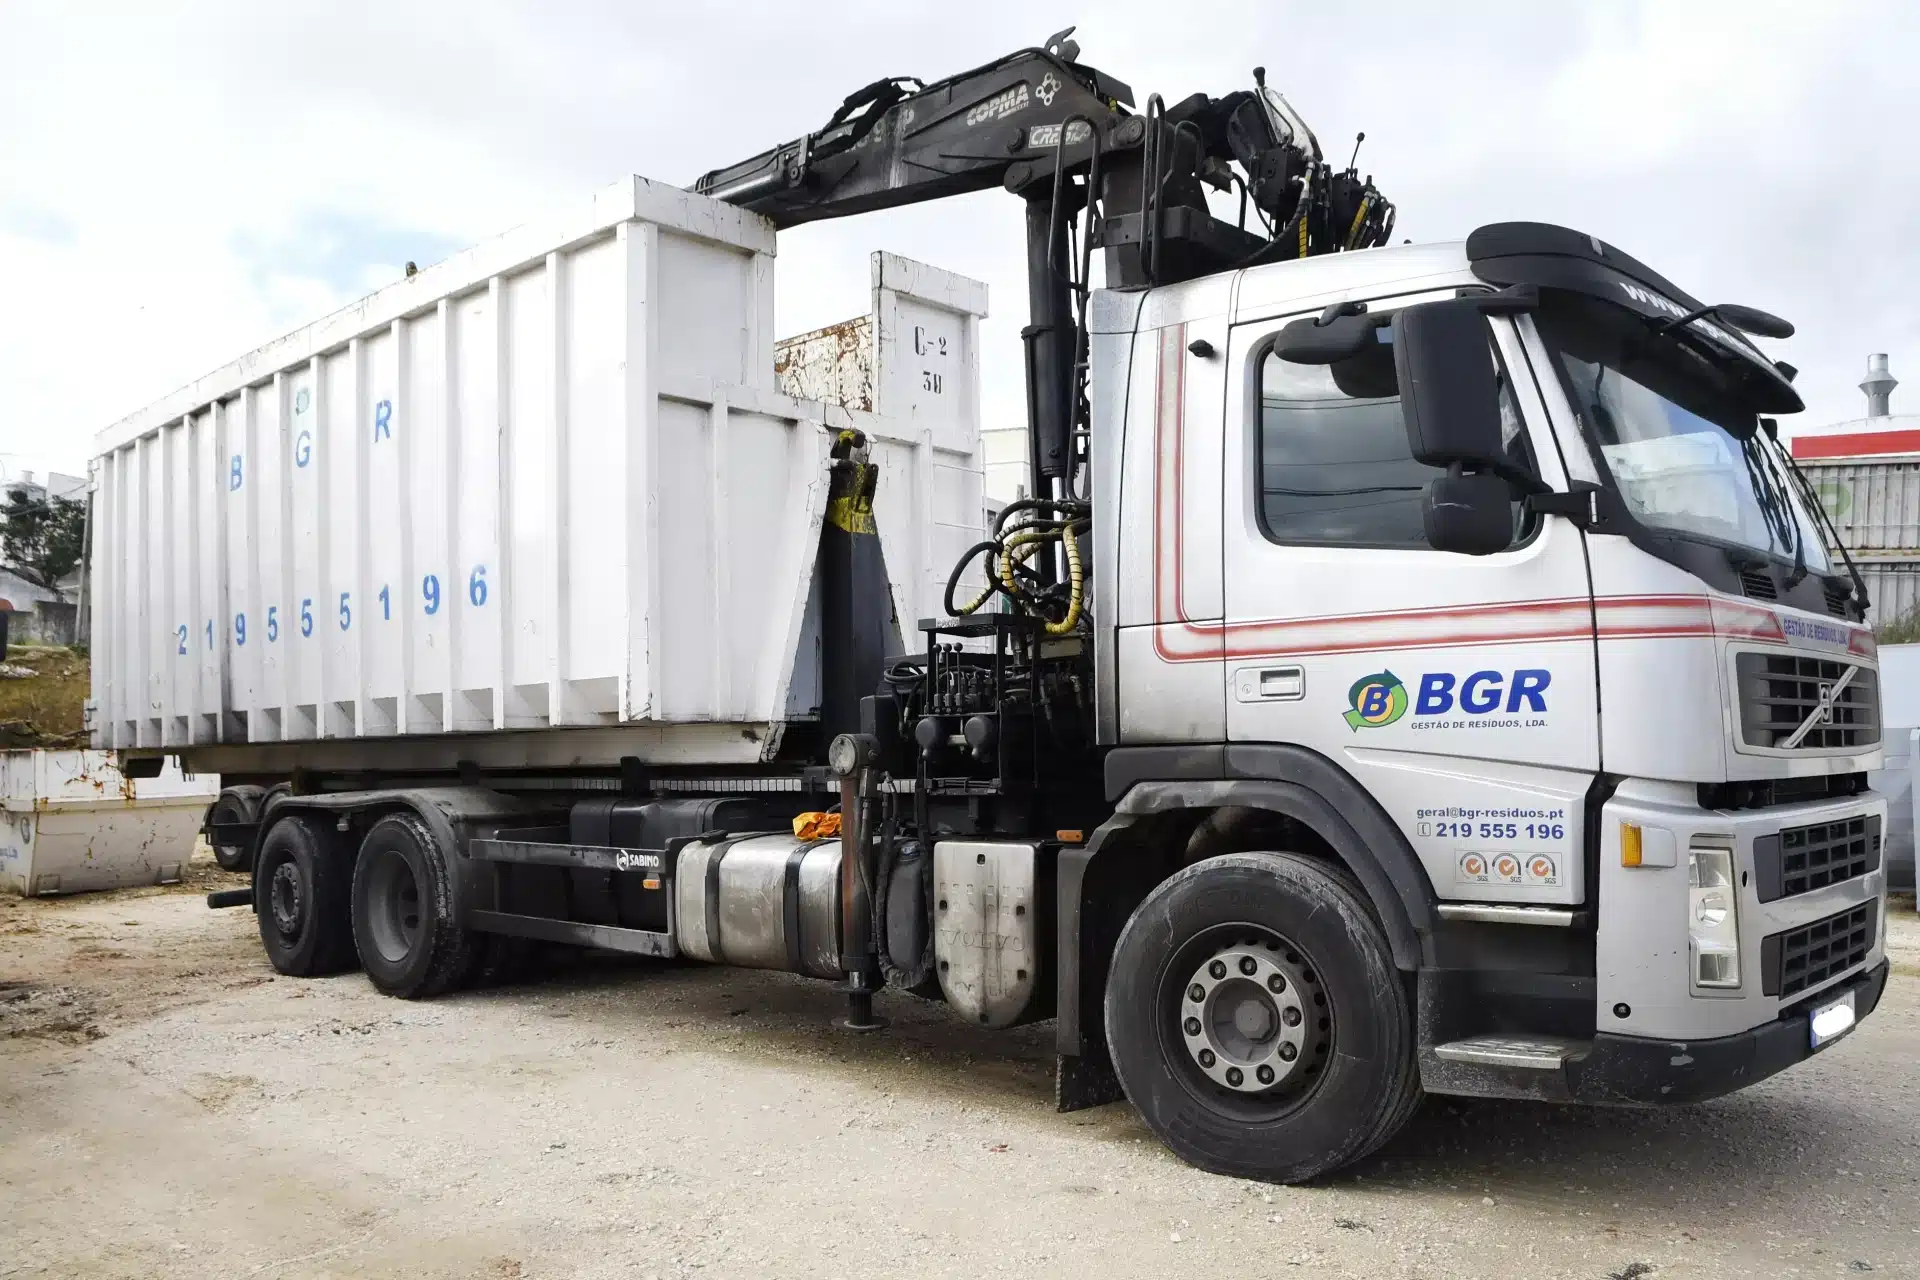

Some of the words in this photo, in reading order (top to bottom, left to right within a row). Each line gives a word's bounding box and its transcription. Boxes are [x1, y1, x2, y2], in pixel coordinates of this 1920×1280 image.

[967, 84, 1029, 126] COPMA
[1414, 669, 1552, 716] BGR
[1361, 686, 1391, 718] B
[1411, 720, 1450, 730] GESTÃO
[1452, 721, 1466, 729] DE
[1468, 718, 1522, 729] RESÍDUOS,
[1525, 719, 1549, 728] LDA.
[1416, 806, 1564, 820] geral@bgr-residuos.pt
[1435, 822, 1472, 838] 219
[1479, 823, 1517, 839] 555
[1525, 824, 1564, 840] 196
[629, 855, 660, 868] SABINO
